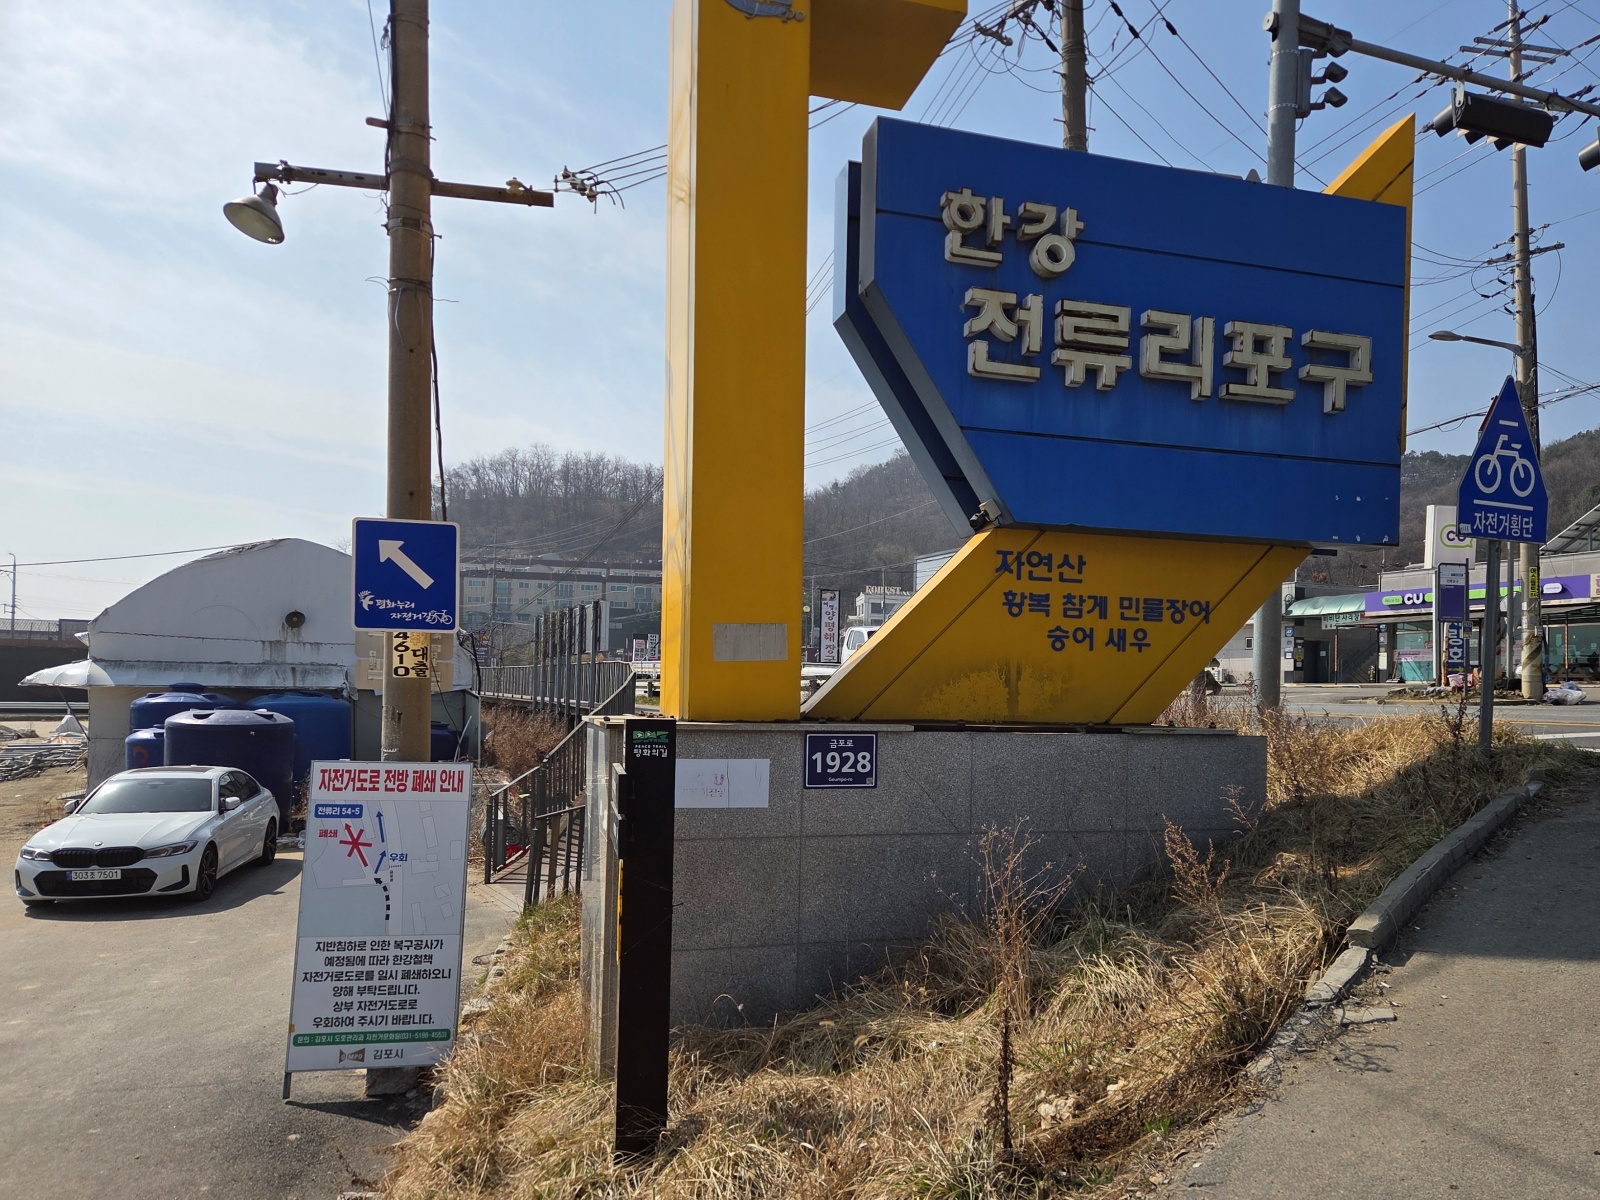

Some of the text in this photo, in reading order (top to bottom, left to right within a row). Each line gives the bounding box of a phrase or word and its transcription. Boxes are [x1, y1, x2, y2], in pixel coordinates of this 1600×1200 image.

[940, 187, 1085, 278] 한강
[963, 285, 1375, 415] 전류리포구
[1473, 510, 1534, 538] 자전거횡단
[995, 549, 1087, 584] 자연산
[375, 598, 416, 610] 평화누리
[1403, 592, 1424, 605] CU
[1002, 589, 1211, 625] 황복 참게 민물장어
[1046, 625, 1152, 653] 숭어 새우
[393, 631, 411, 677] 4610
[410, 645, 429, 678] 대출
[829, 738, 855, 749] 금포로
[633, 748, 668, 758] 평화의길
[811, 751, 872, 773] 1928
[318, 768, 465, 793] 자전거도로 전방 폐쇄 안내
[317, 807, 361, 816] 전류리 54-5
[318, 828, 338, 838] 폐쇄
[389, 853, 408, 862] 우회
[97, 870, 118, 879] 7501
[315, 939, 444, 952] 지반침하로 인한 복구공사가
[324, 954, 434, 967] 예정됨에 따라 한강철책
[301, 968, 452, 983] 자전거로도로를 일시 폐쇄하오니
[332, 984, 421, 997] 양해 부탁드립니다.
[332, 999, 418, 1013] 상부 자전거도로로
[312, 1013, 435, 1029] 우회하여 주시기 바랍니다.
[297, 1035, 310, 1044] 문의
[314, 1035, 333, 1043] 김포시
[373, 1048, 404, 1060] 김포시
